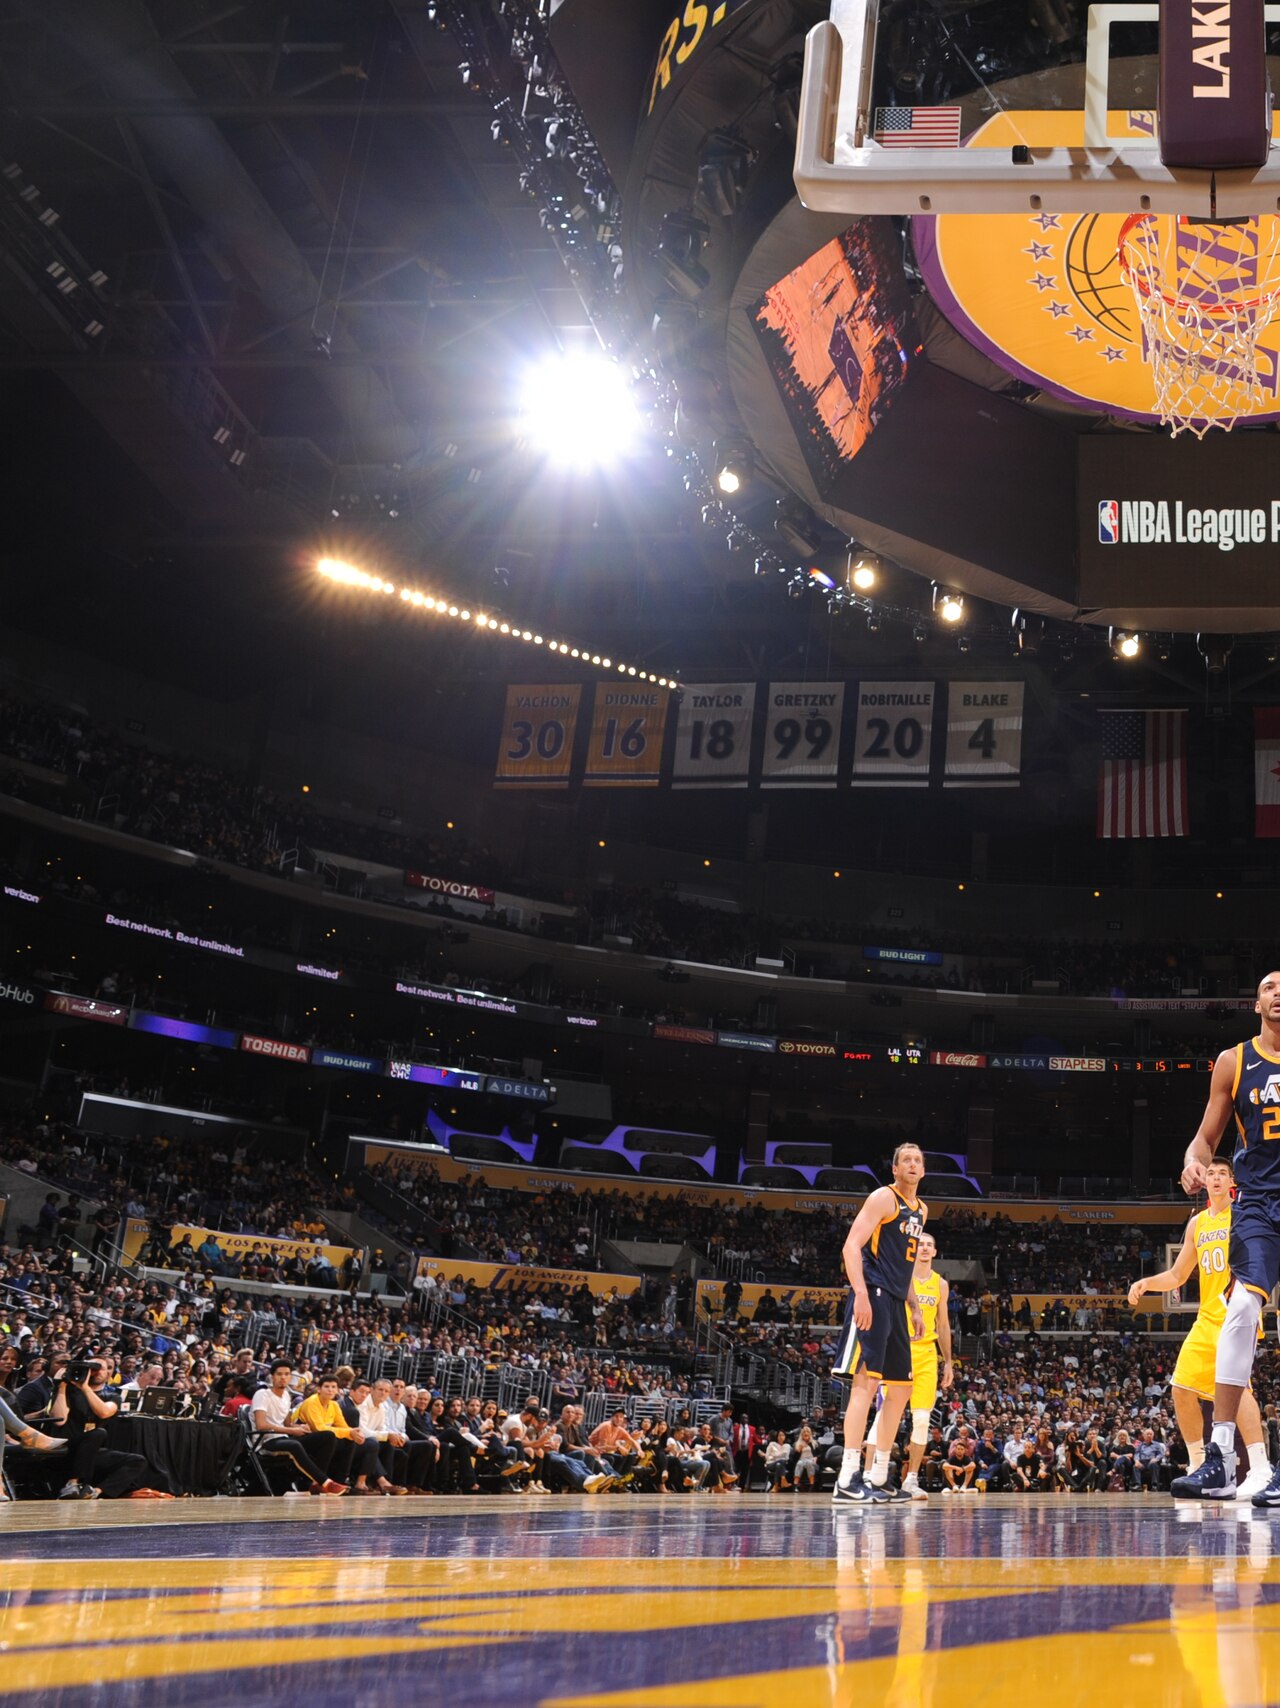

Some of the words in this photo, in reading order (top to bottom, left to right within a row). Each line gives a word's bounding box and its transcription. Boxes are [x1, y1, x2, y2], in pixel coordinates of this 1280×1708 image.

[1191, 0, 1231, 98] LAK
[1121, 501, 1172, 543] NBA
[1175, 501, 1266, 552] League
[516, 695, 571, 708] VACHON
[605, 694, 658, 706] DIONNE
[692, 695, 743, 708] TAYLOR
[774, 694, 837, 707] GRETZKY
[861, 694, 931, 706] ROBITAILLE
[963, 694, 1009, 706] BLAKE
[507, 720, 565, 760] 30
[602, 718, 647, 759] 16
[690, 719, 735, 760] 18
[774, 718, 832, 760] 99
[863, 717, 923, 759] 20
[968, 718, 997, 759] 4
[4, 886, 40, 903] verizon
[420, 876, 480, 899] TOYOTA
[105, 913, 130, 929] Best
[131, 920, 173, 939] network.
[176, 931, 199, 945] Best
[199, 939, 244, 957] unlimited.
[879, 950, 899, 960] BUD
[900, 951, 926, 962] LIGHT
[297, 964, 338, 980] unlimited
[396, 982, 416, 995] Best
[417, 987, 455, 1002] network.
[457, 995, 477, 1007] Best
[477, 999, 517, 1013] unlimited.
[567, 1016, 597, 1026] verizon
[243, 1037, 307, 1060] TOSHIBA
[796, 1044, 836, 1055] TOYOTA
[888, 1048, 901, 1056] LAL
[906, 1049, 921, 1057] UTA
[323, 1055, 343, 1066] BUD
[344, 1058, 372, 1070] LIGHT
[390, 1061, 411, 1072] WAS
[889, 1055, 900, 1063] 18
[1004, 1058, 1045, 1068] DELTA
[1050, 1058, 1104, 1071] STAPLES
[390, 1069, 410, 1081] CHC
[461, 1080, 478, 1091] MLB
[504, 1083, 547, 1099] DELTA
[1197, 1228, 1229, 1248] LAKERS
[1200, 1247, 1226, 1275] 40
[515, 1270, 535, 1278] LOS
[536, 1272, 589, 1281] ANGELES
